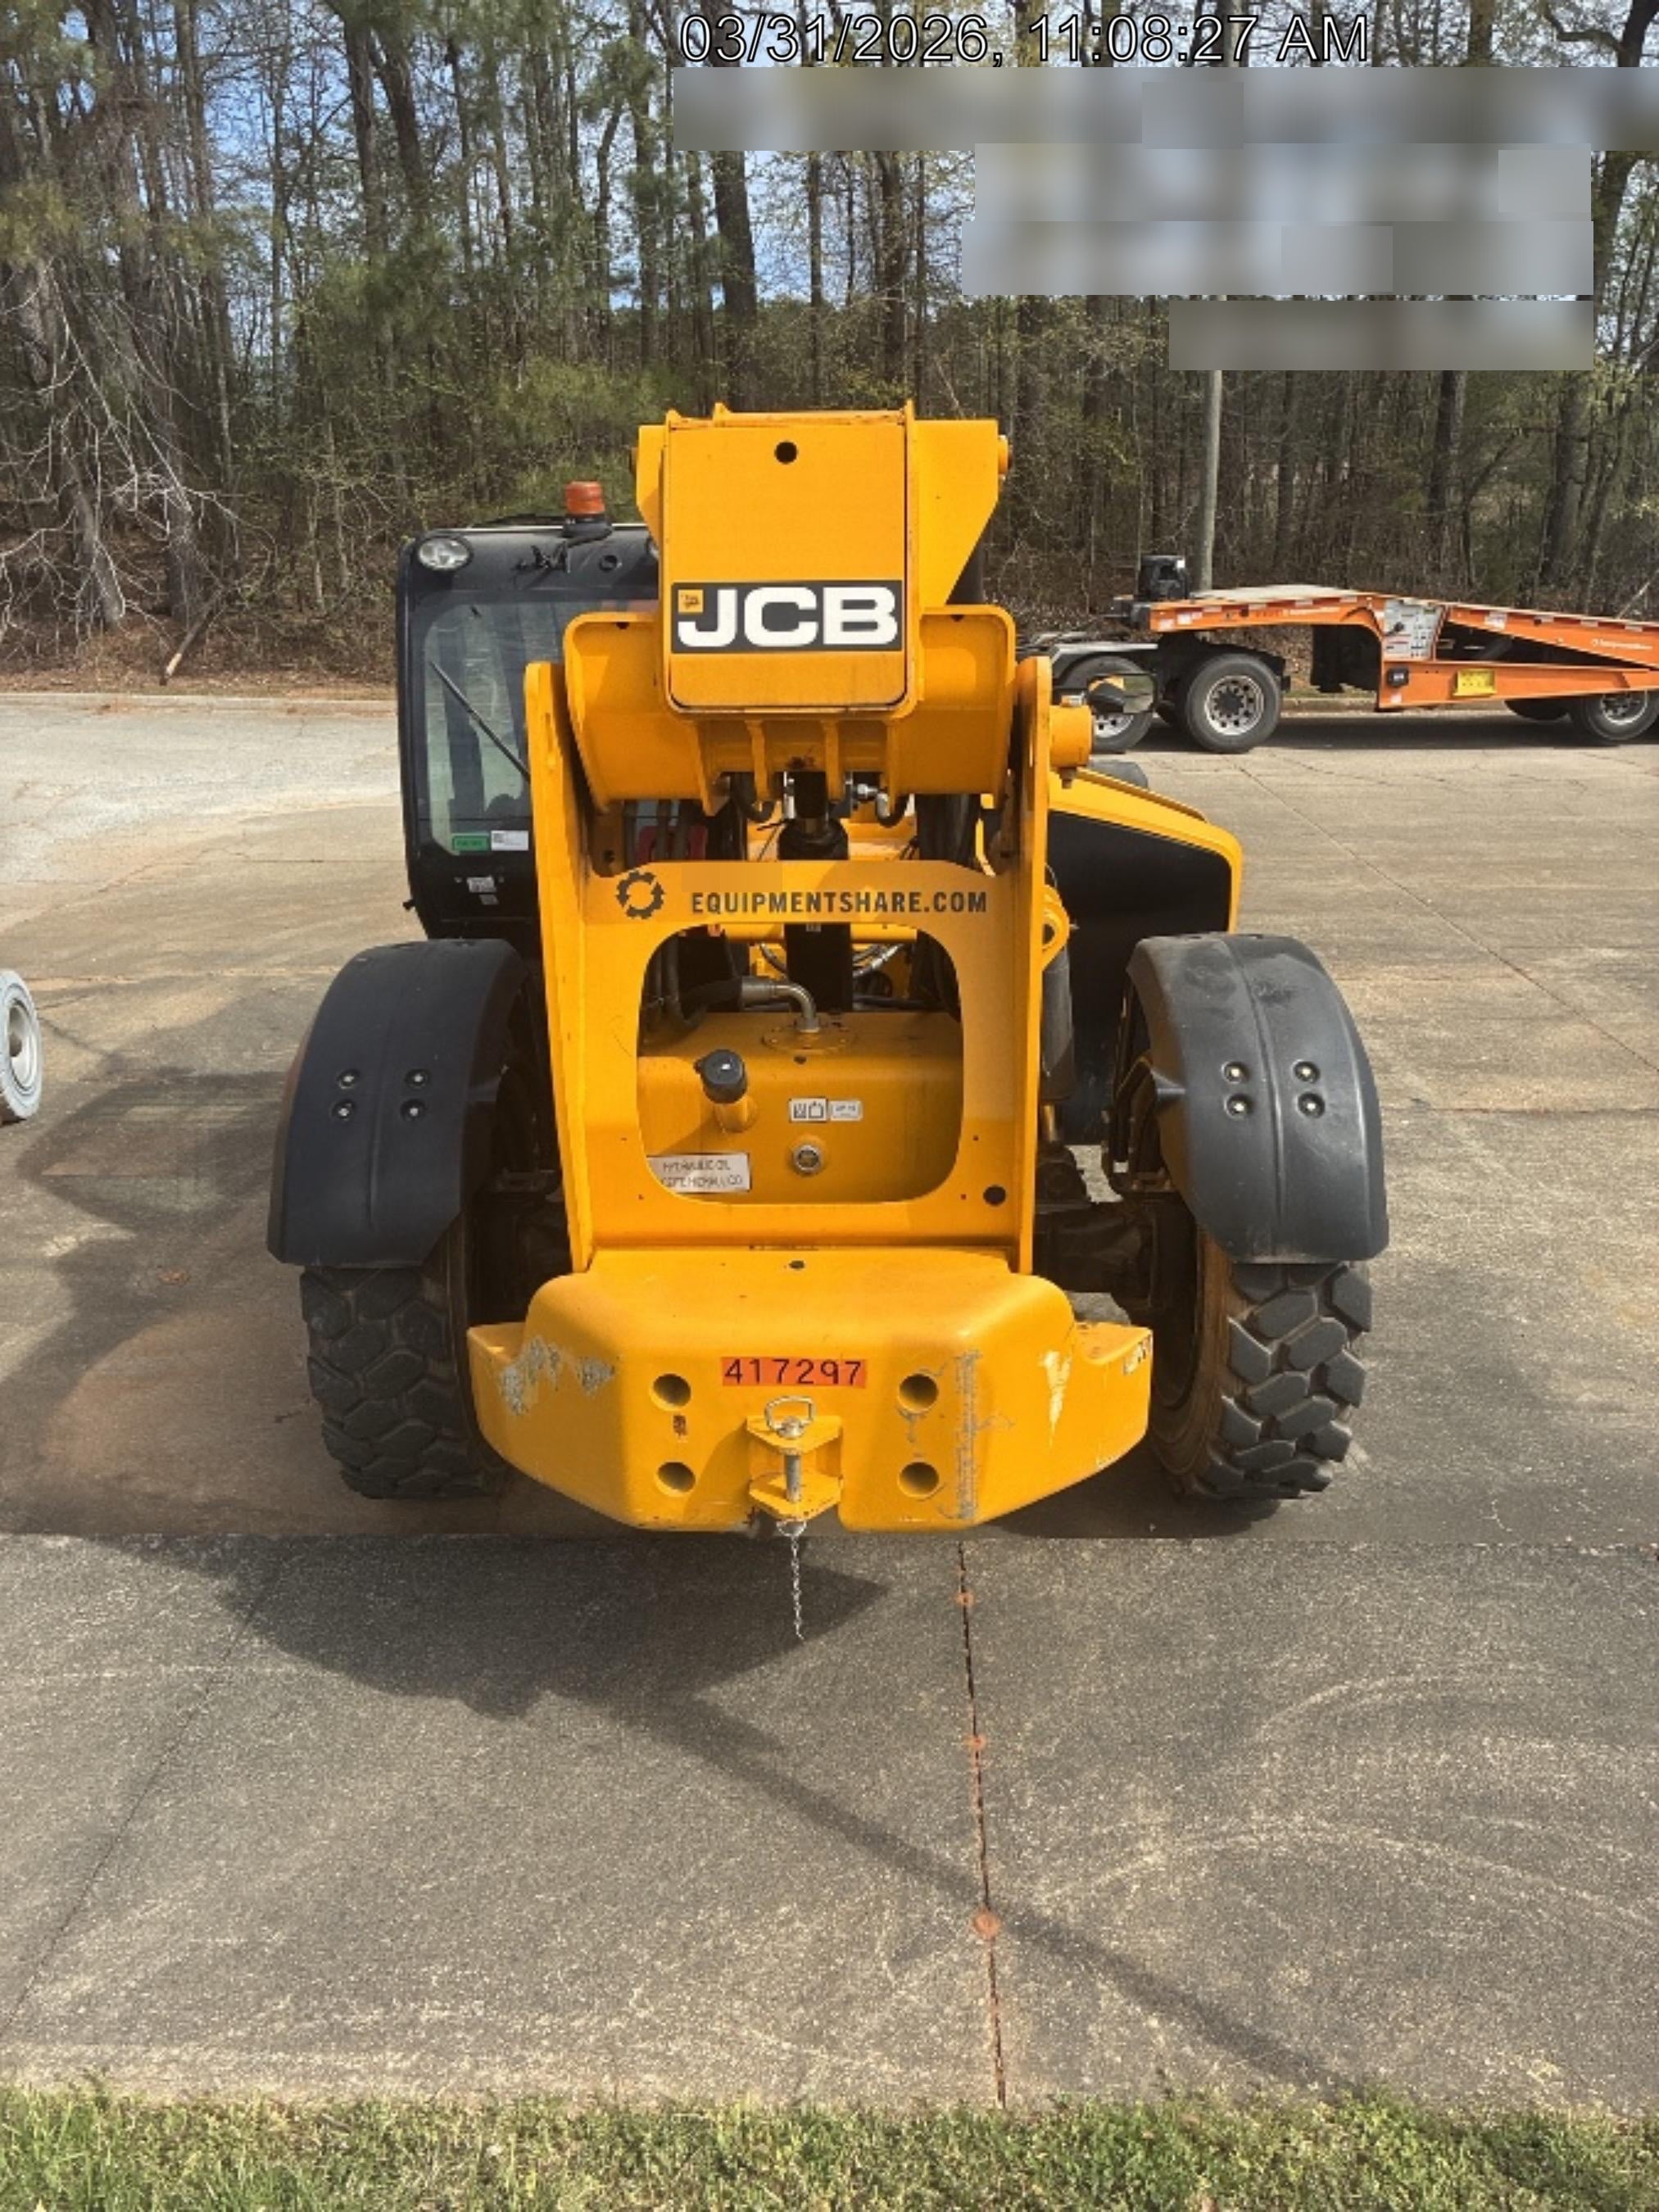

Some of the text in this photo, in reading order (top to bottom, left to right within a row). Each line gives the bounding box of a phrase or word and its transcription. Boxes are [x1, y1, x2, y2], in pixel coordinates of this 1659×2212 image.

[678, 587, 898, 647] JCB
[691, 891, 987, 913] EQUIPMENTSHARE.COM
[724, 1358, 862, 1385] 417297
